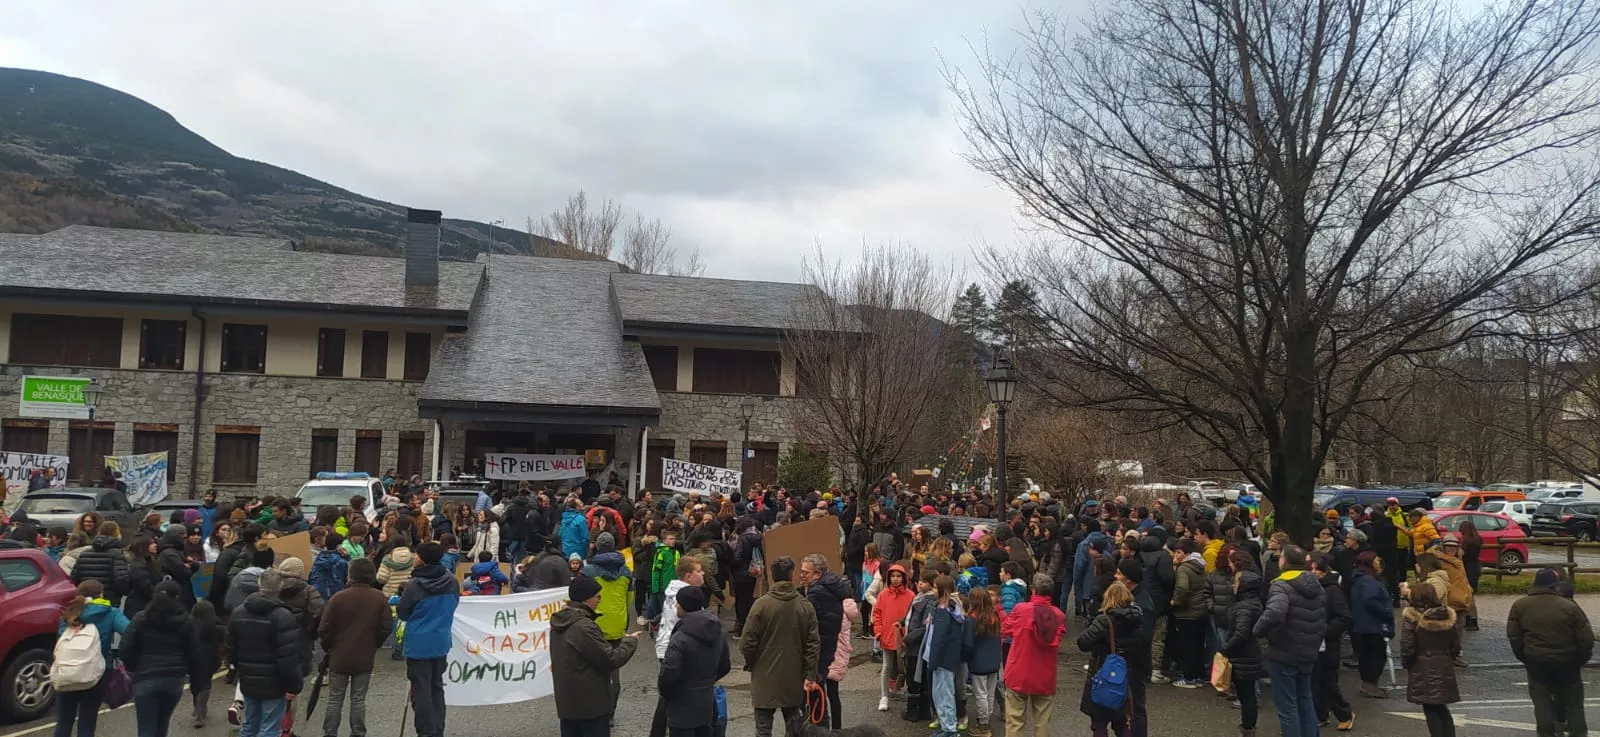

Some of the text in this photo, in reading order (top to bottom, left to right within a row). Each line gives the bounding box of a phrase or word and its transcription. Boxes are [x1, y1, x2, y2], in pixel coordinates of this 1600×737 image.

[36, 383, 83, 393] VALLE DE
[31, 390, 85, 403] BENASQUE
[20, 453, 57, 468] VALLE
[520, 460, 534, 473] EN
[535, 460, 550, 472] EL
[551, 456, 583, 471] VALLE
[705, 474, 718, 482] NO
[724, 470, 737, 480] DE
